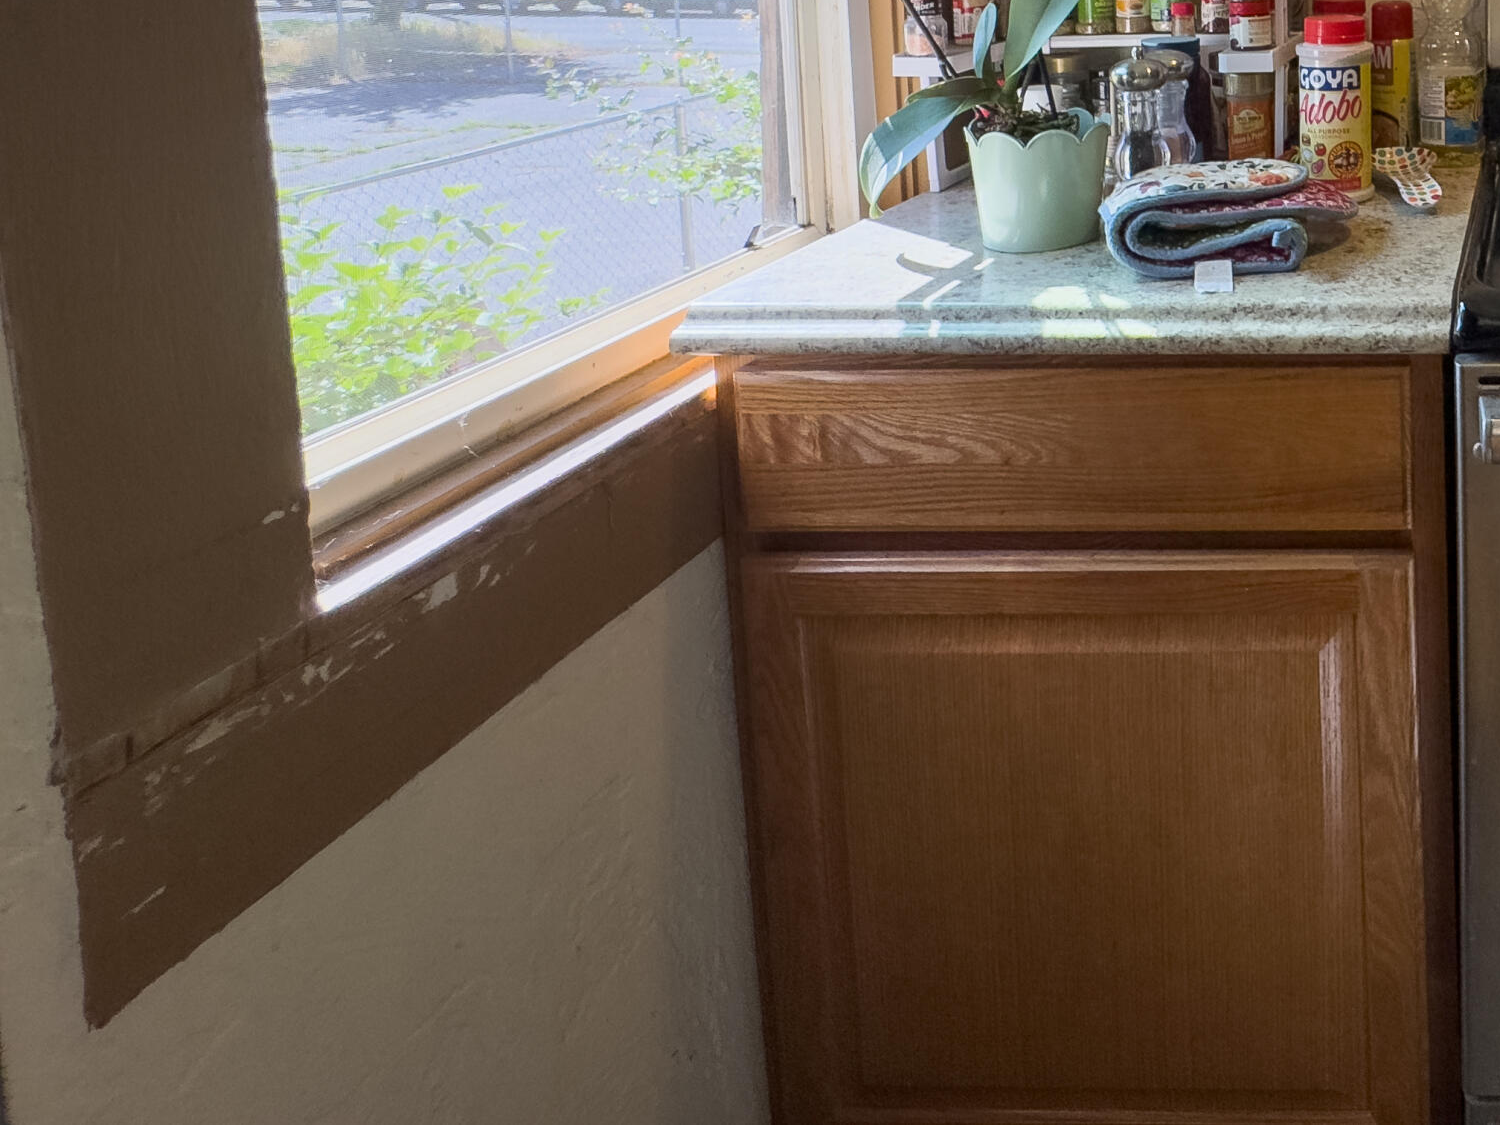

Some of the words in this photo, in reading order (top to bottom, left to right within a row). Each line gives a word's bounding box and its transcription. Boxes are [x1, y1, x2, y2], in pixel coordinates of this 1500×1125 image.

[1372, 44, 1392, 69] AM
[1300, 69, 1358, 89] GOYA
[1300, 89, 1362, 125] Adobo
